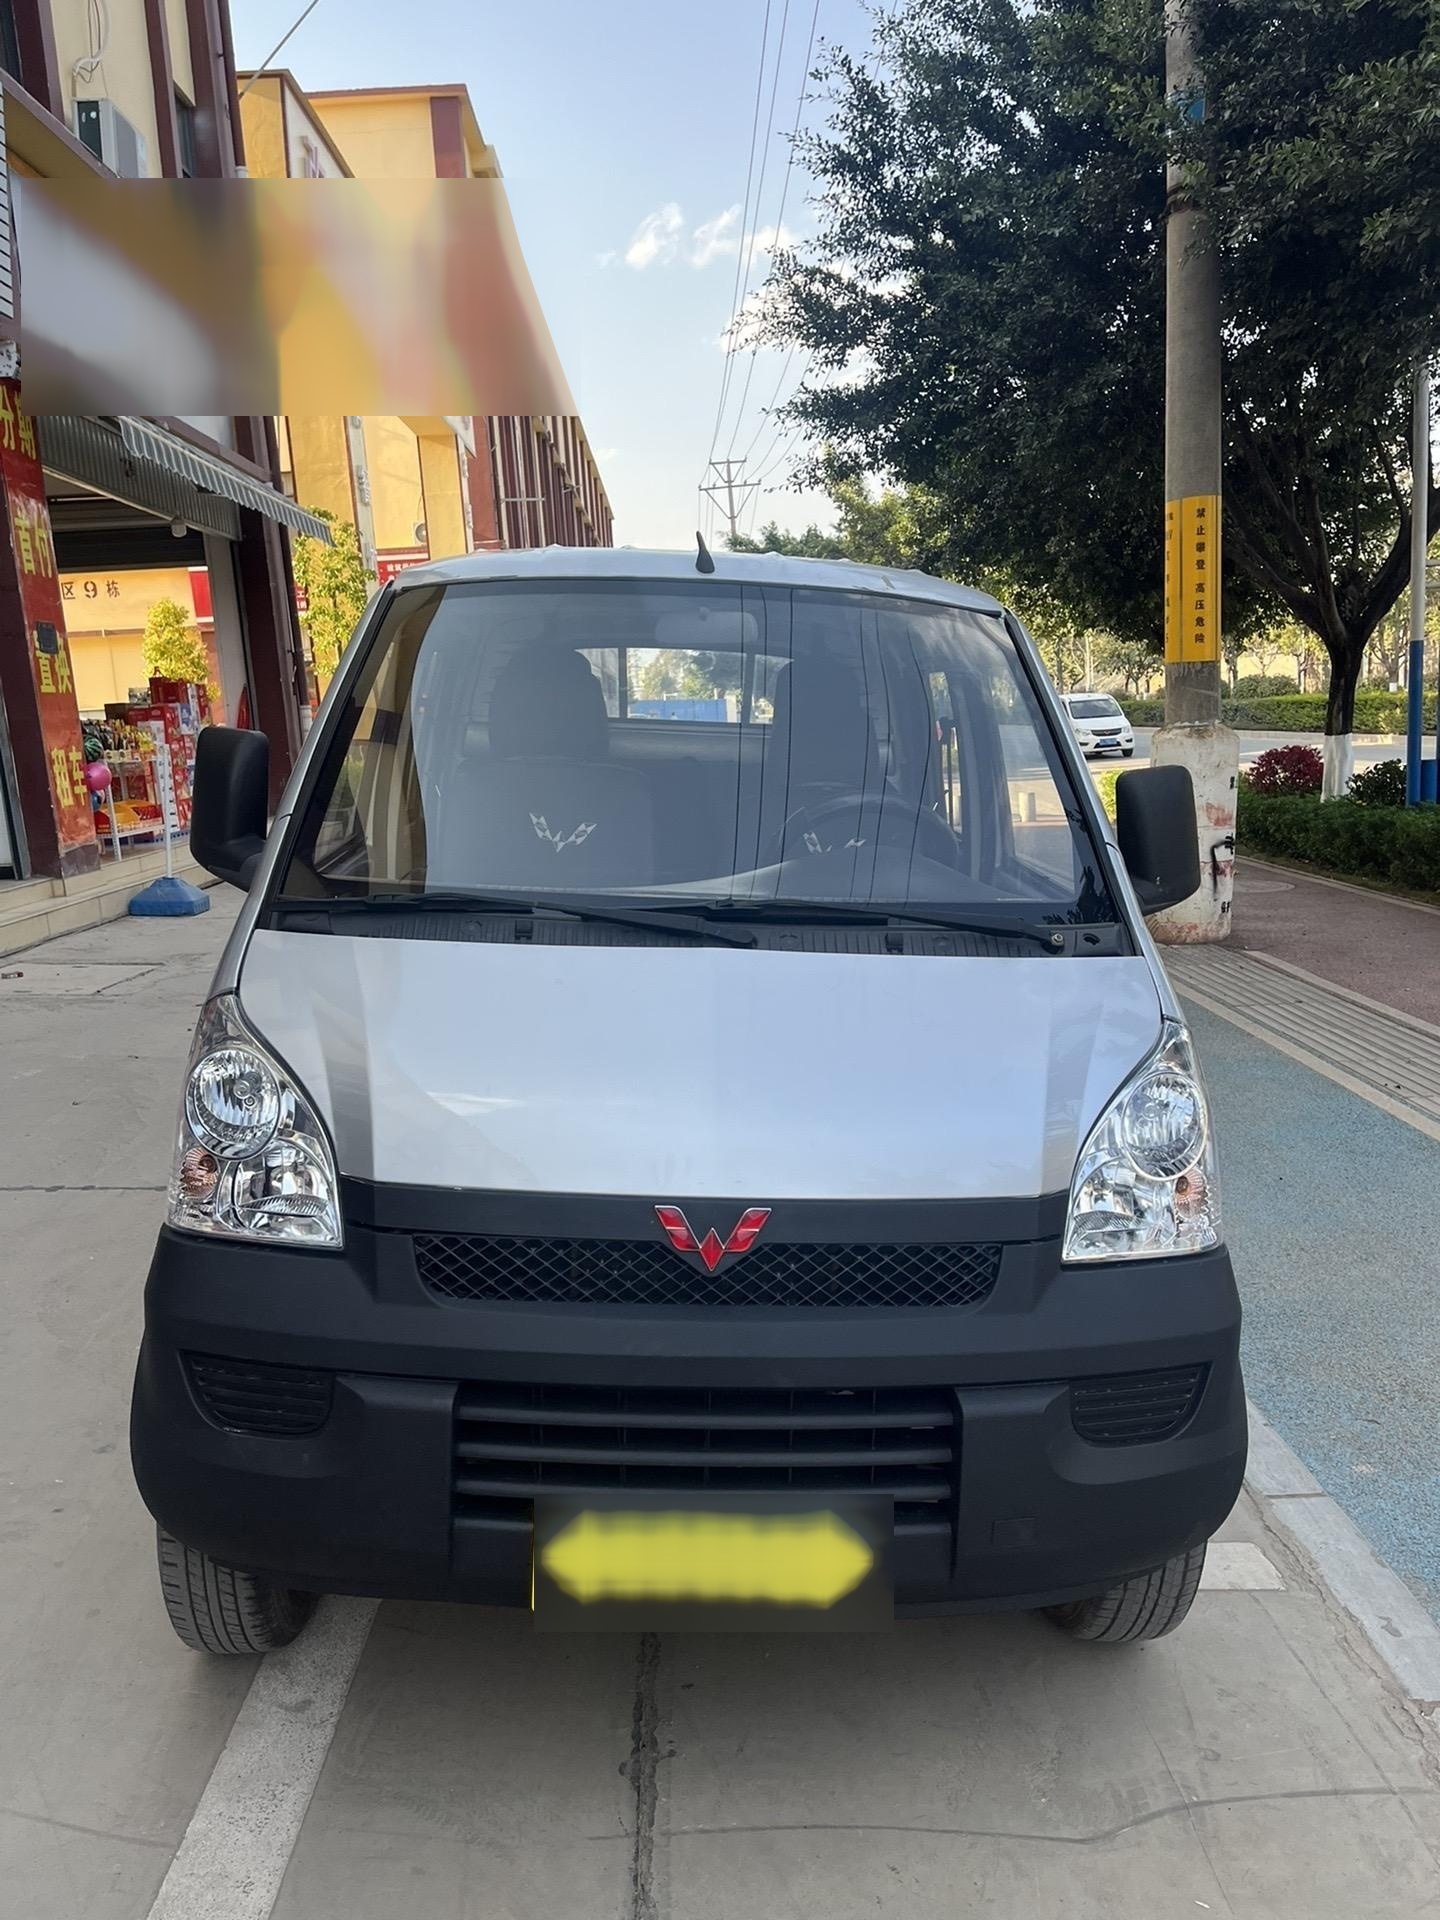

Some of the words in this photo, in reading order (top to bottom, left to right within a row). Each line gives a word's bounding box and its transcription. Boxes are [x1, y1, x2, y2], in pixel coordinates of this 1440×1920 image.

[14, 502, 53, 578] 首付
[1194, 582, 1206, 644] 高压危险
[51, 745, 88, 808] 租车
